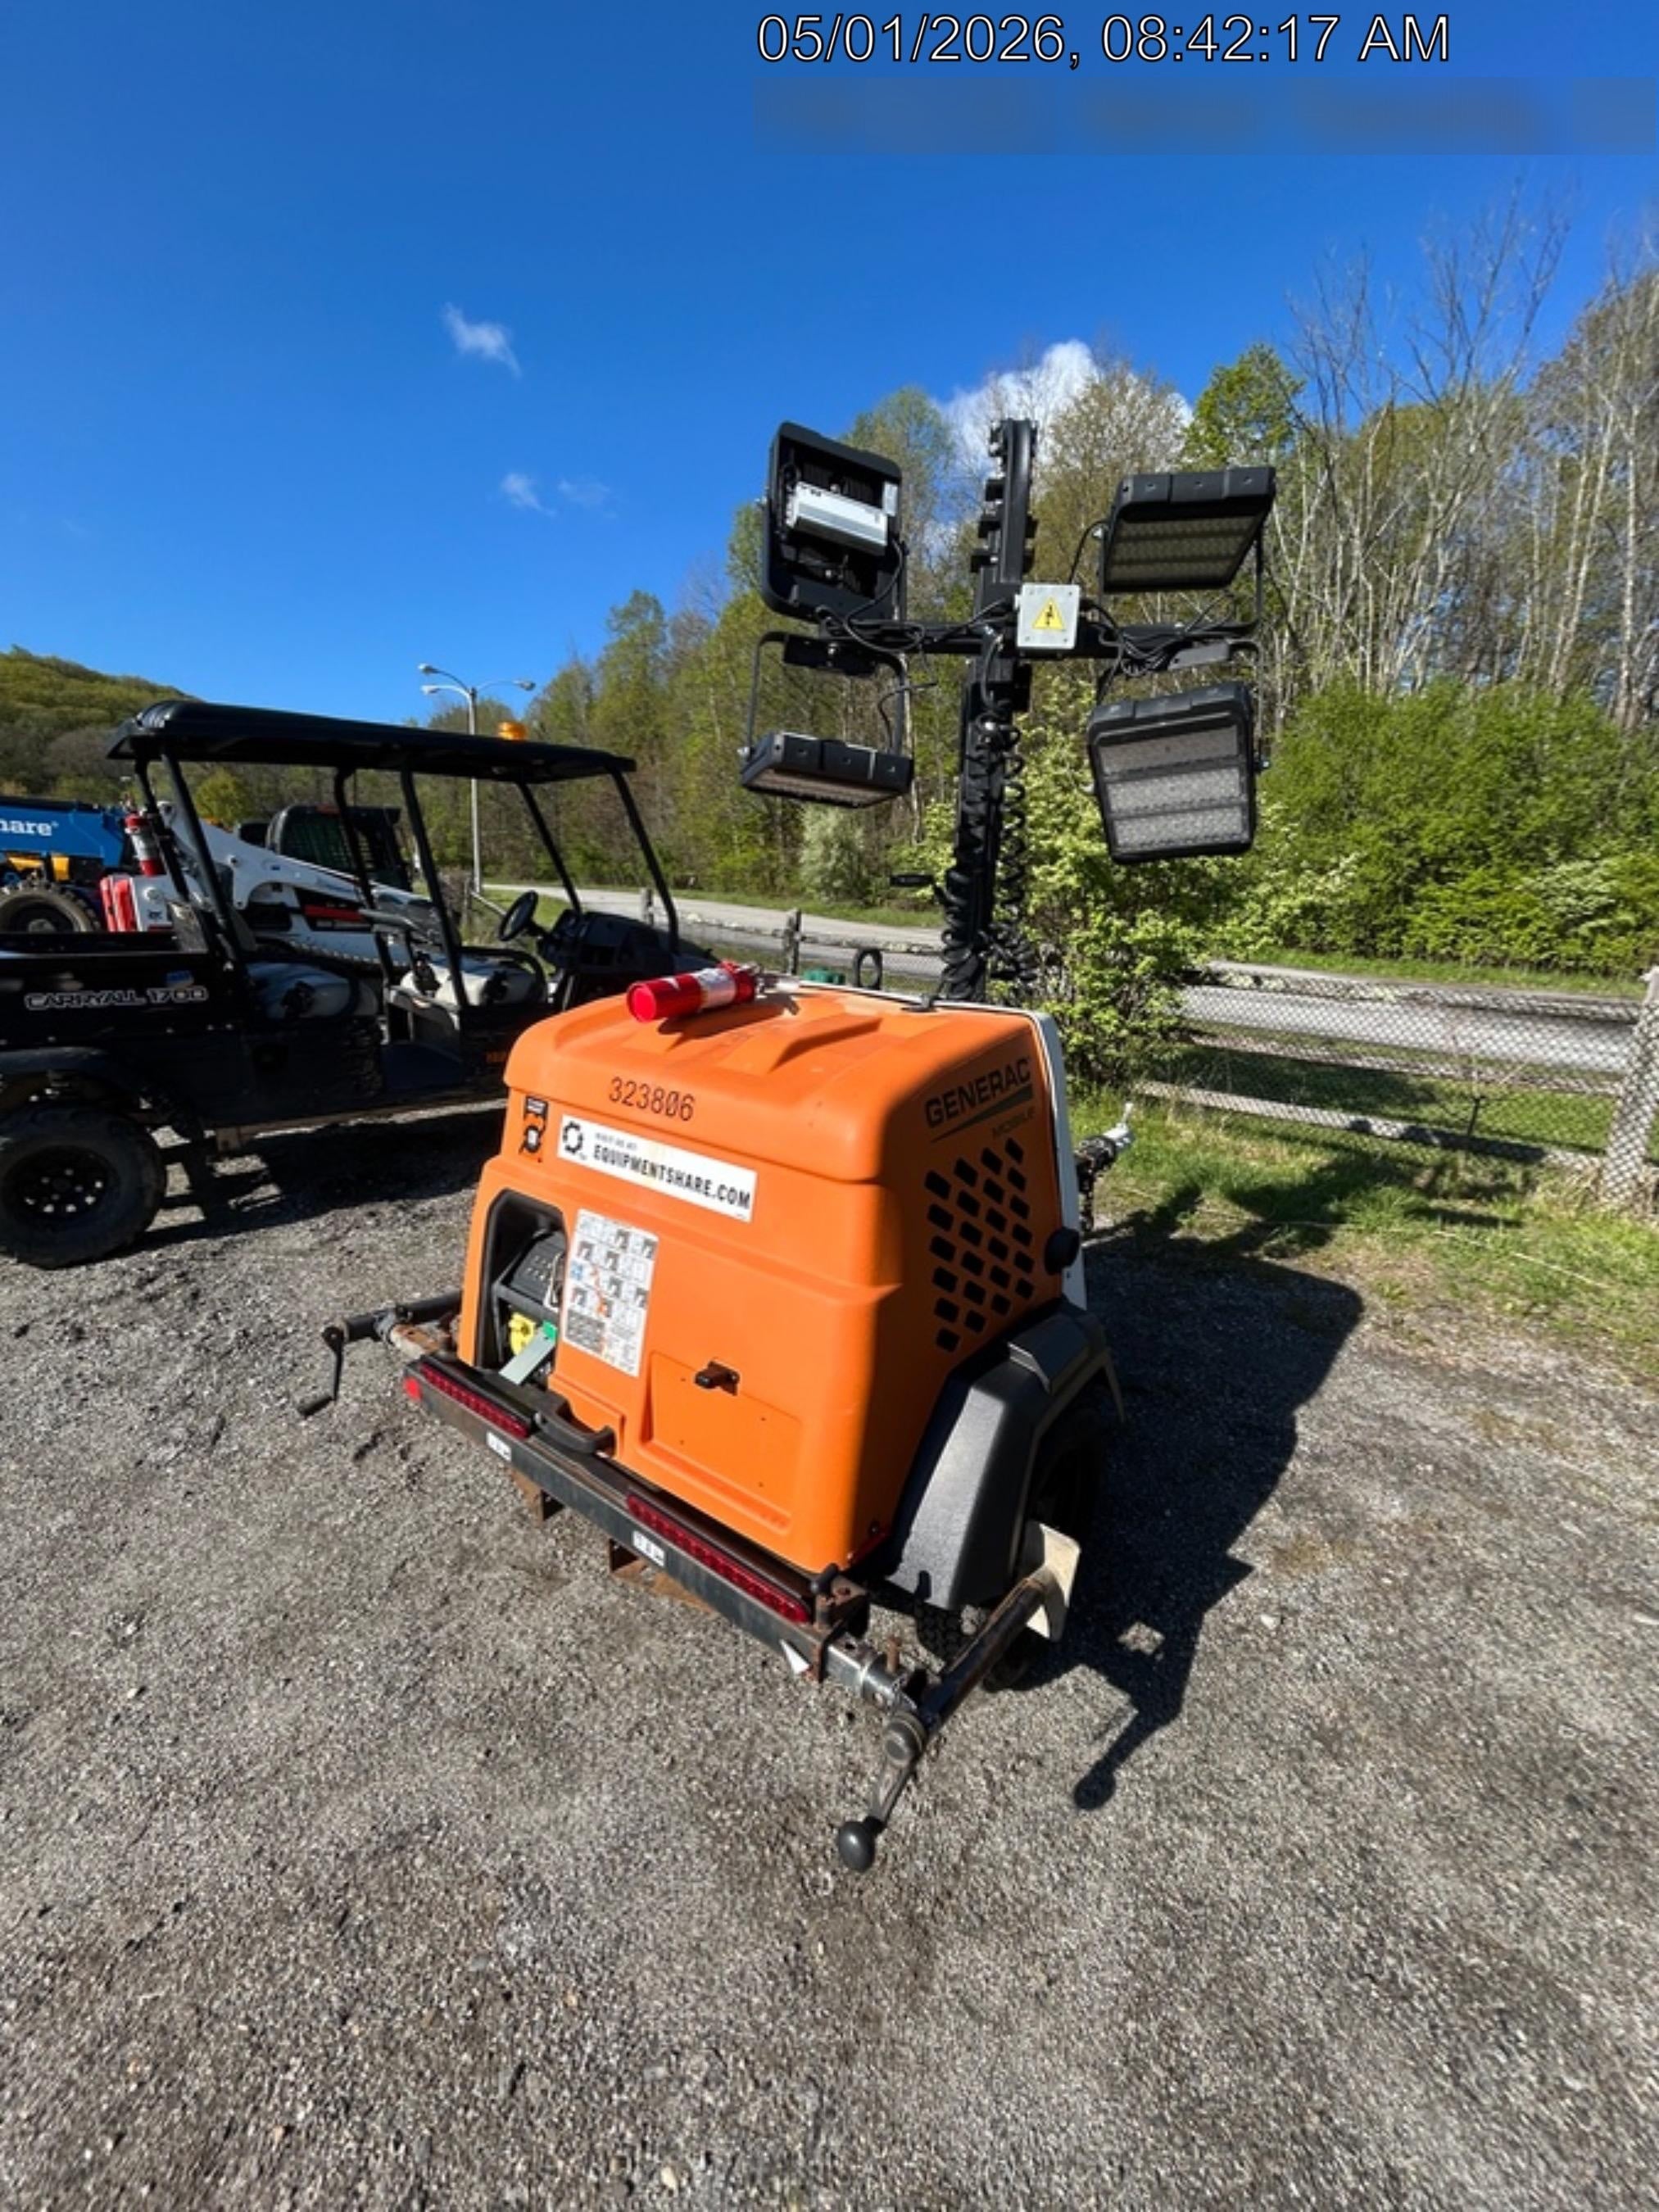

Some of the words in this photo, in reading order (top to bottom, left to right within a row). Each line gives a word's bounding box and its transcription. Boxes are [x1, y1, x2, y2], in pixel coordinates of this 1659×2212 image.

[24, 990, 147, 1011] CARRYALL
[146, 986, 210, 1004] 1700
[609, 1076, 696, 1122] 323806
[925, 1057, 1032, 1129] GENERAC
[593, 1144, 751, 1210] EQUIPMENTSHARE.COM
